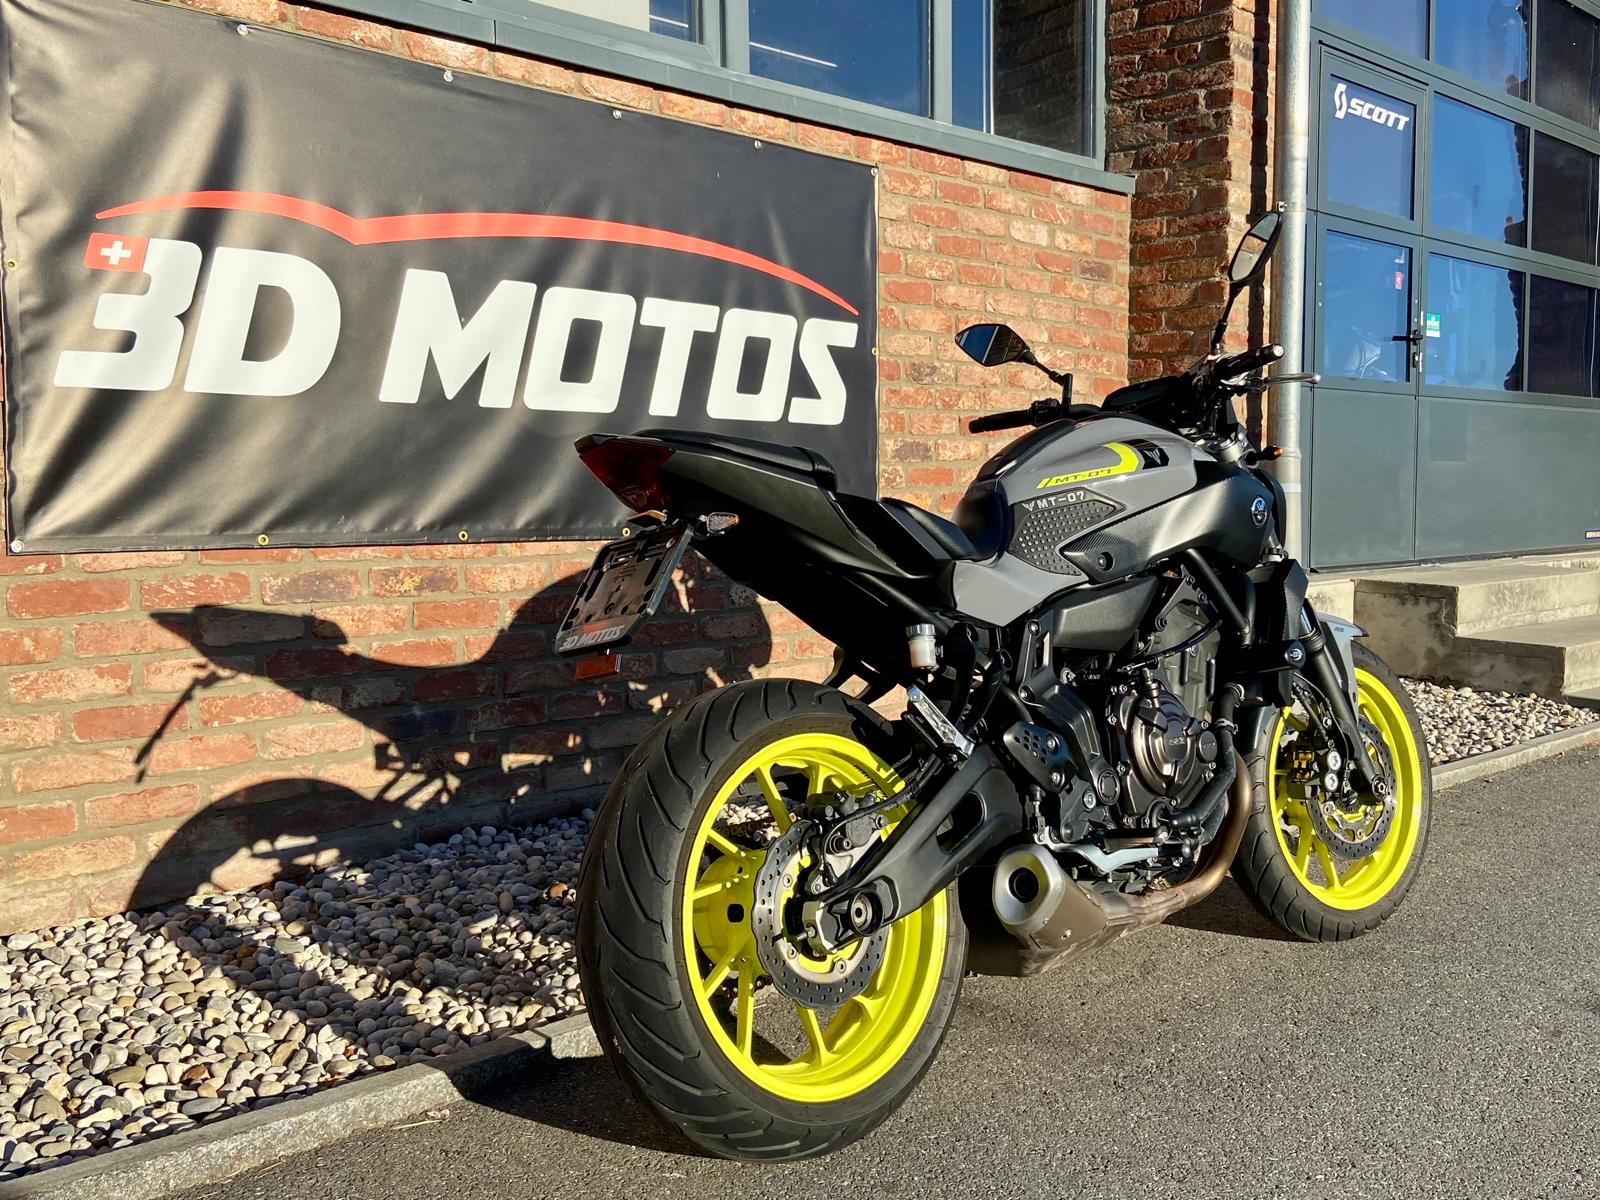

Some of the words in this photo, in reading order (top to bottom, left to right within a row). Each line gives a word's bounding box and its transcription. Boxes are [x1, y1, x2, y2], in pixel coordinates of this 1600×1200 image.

[1347, 97, 1410, 131] SCOTT
[54, 236, 342, 397] 3D
[379, 268, 859, 425] MOTOS
[1055, 468, 1111, 484] MT-07
[1037, 491, 1085, 509] MT-07
[576, 625, 625, 647] MOTOS
